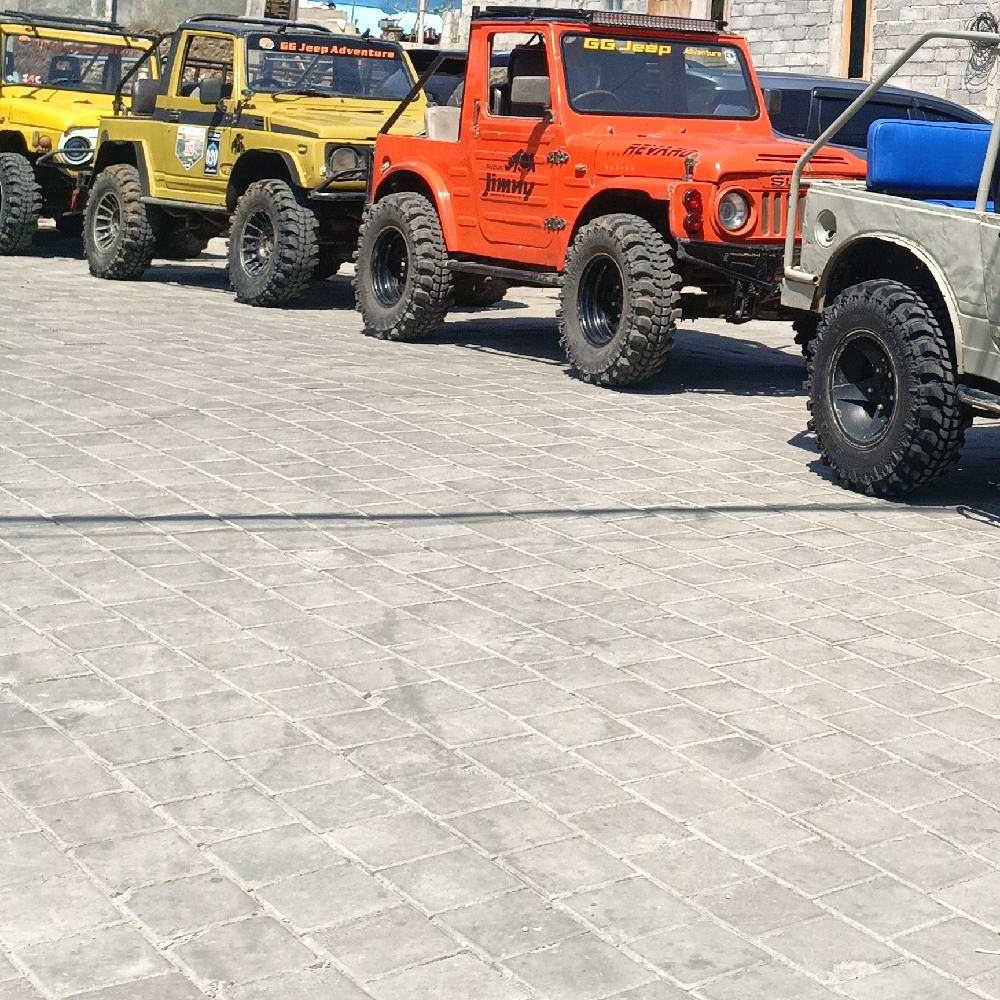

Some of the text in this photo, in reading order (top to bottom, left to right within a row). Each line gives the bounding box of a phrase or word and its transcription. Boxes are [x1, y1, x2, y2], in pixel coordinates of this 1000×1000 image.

[280, 41, 395, 58] GG Jeep Adventure
[583, 38, 672, 56] GG Jeep
[683, 47, 722, 57] Adventure
[482, 172, 535, 201] Jimny
